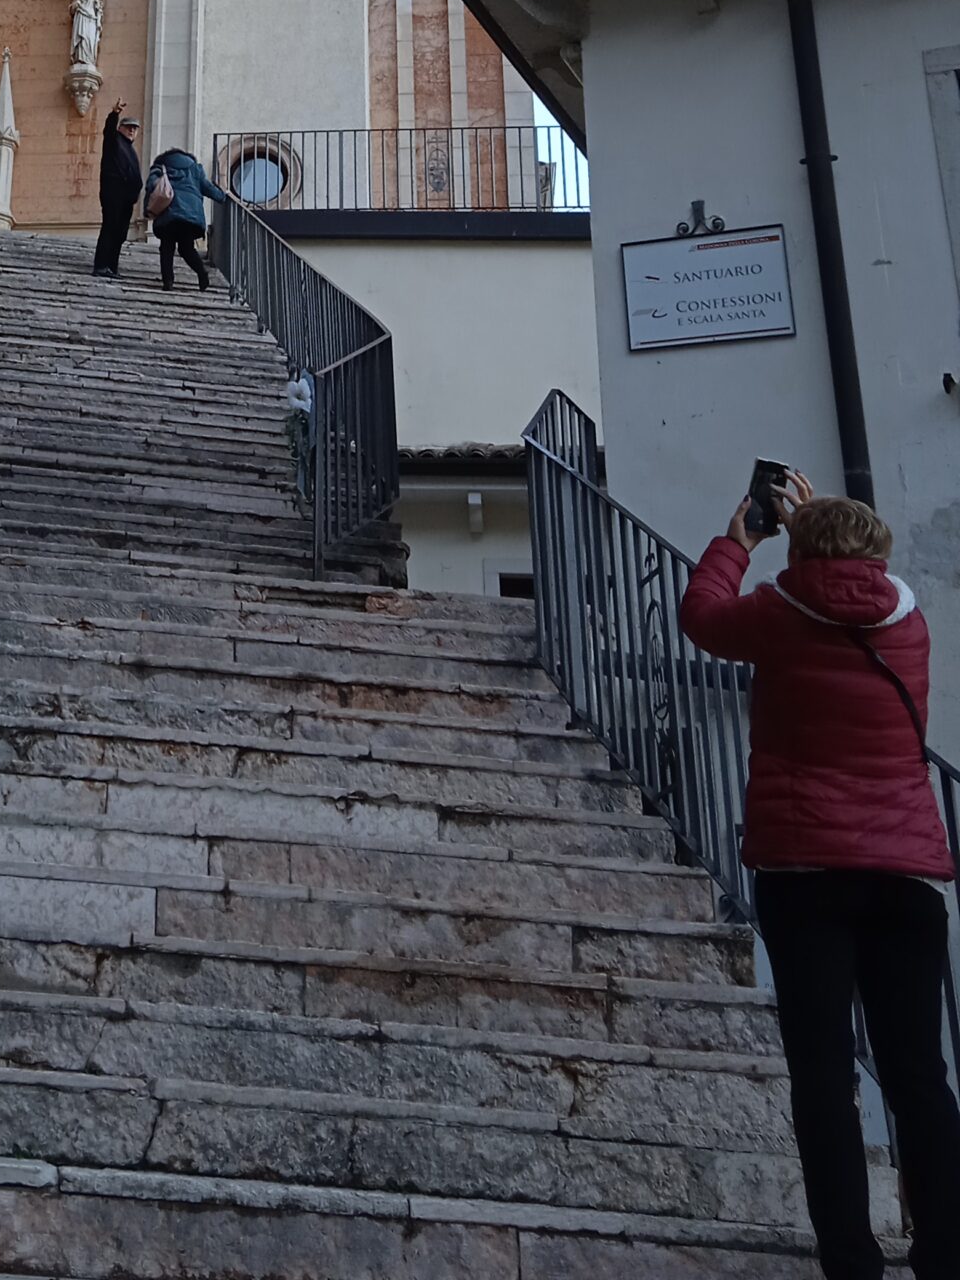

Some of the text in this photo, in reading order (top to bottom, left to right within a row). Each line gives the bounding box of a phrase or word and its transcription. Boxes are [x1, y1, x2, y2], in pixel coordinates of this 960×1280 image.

[673, 264, 762, 284] SANTUARIO
[676, 291, 782, 313] CONFESSIONI
[677, 309, 766, 326] E SCALA SANTA
